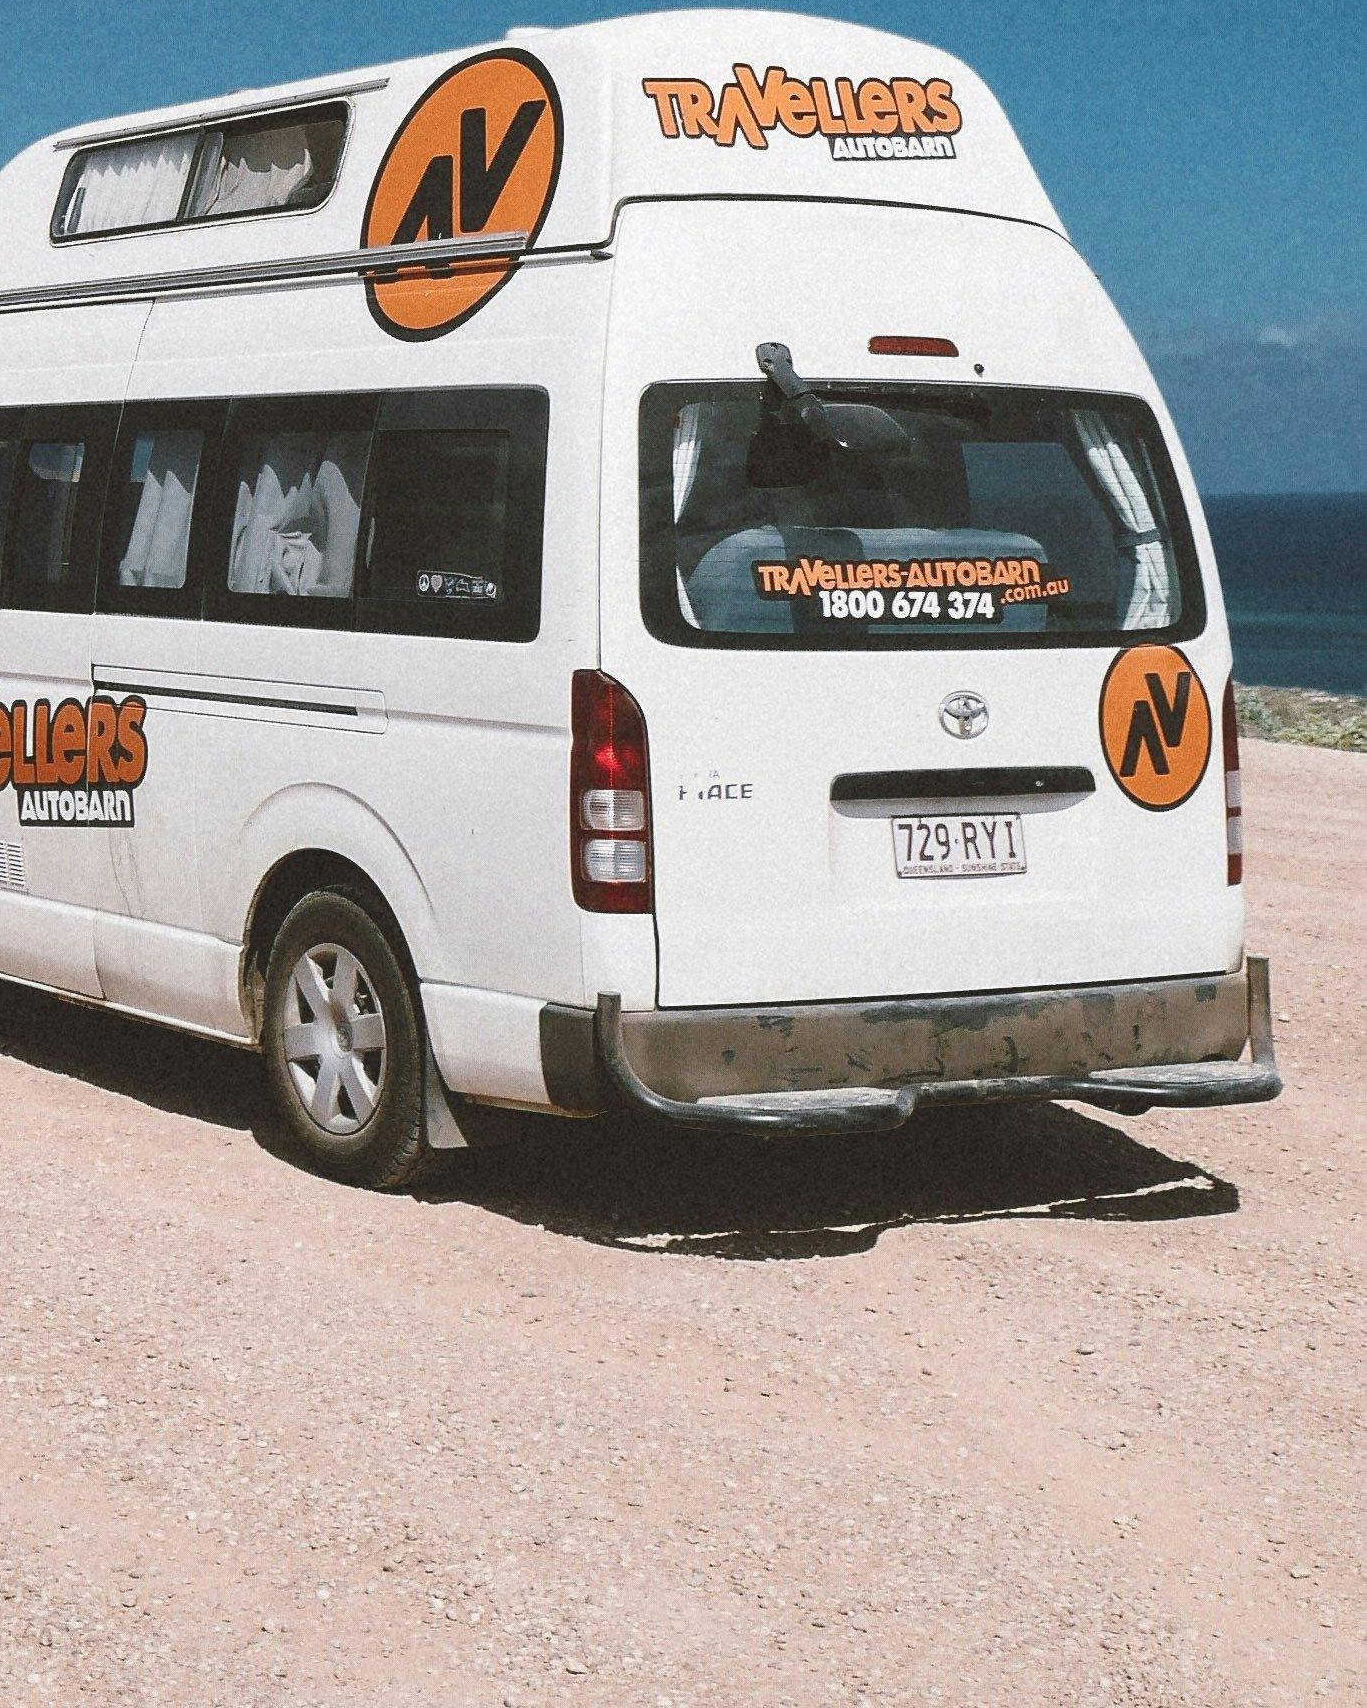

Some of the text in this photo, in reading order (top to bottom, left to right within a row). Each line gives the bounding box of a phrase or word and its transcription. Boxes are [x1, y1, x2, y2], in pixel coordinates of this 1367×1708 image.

[818, 590, 995, 620] 1800 674 374
